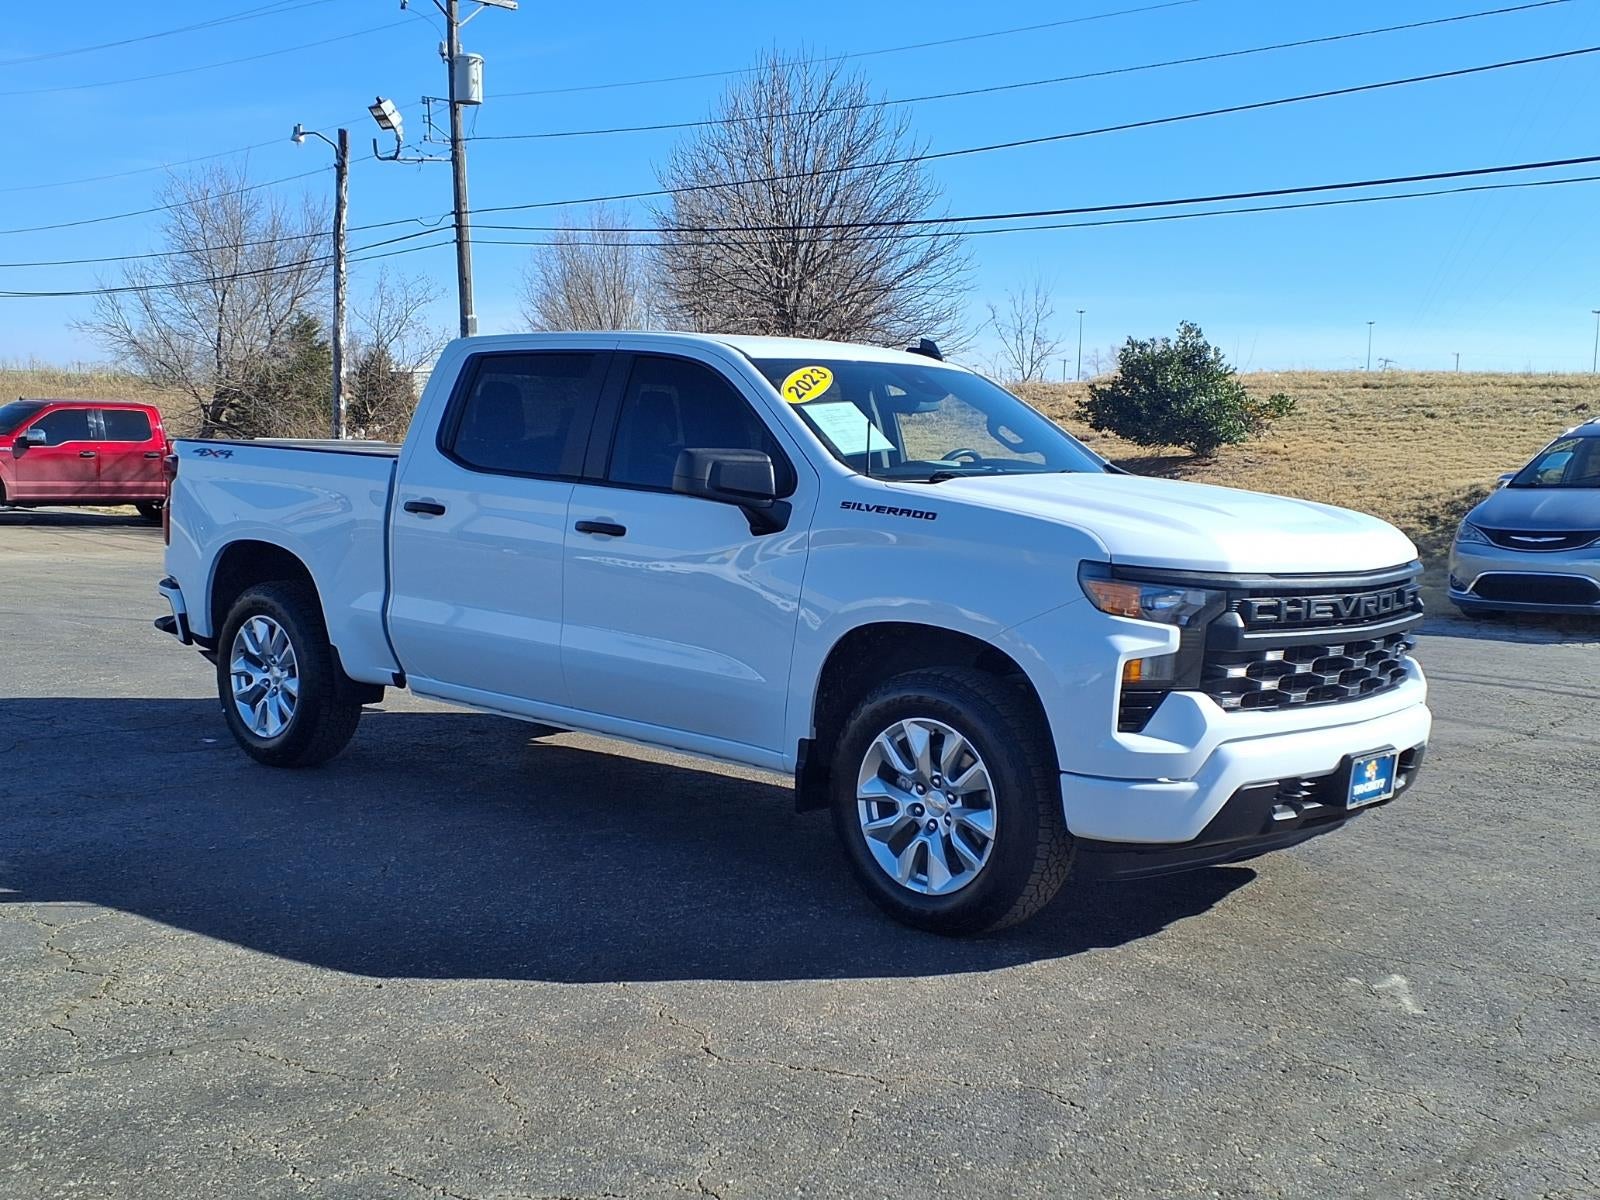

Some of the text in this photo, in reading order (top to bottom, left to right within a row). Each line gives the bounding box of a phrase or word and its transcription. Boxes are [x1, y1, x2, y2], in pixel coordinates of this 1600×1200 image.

[788, 368, 828, 400] 2023
[840, 501, 938, 520] SILVERADO
[1250, 589, 1415, 623] CHEVROLE
